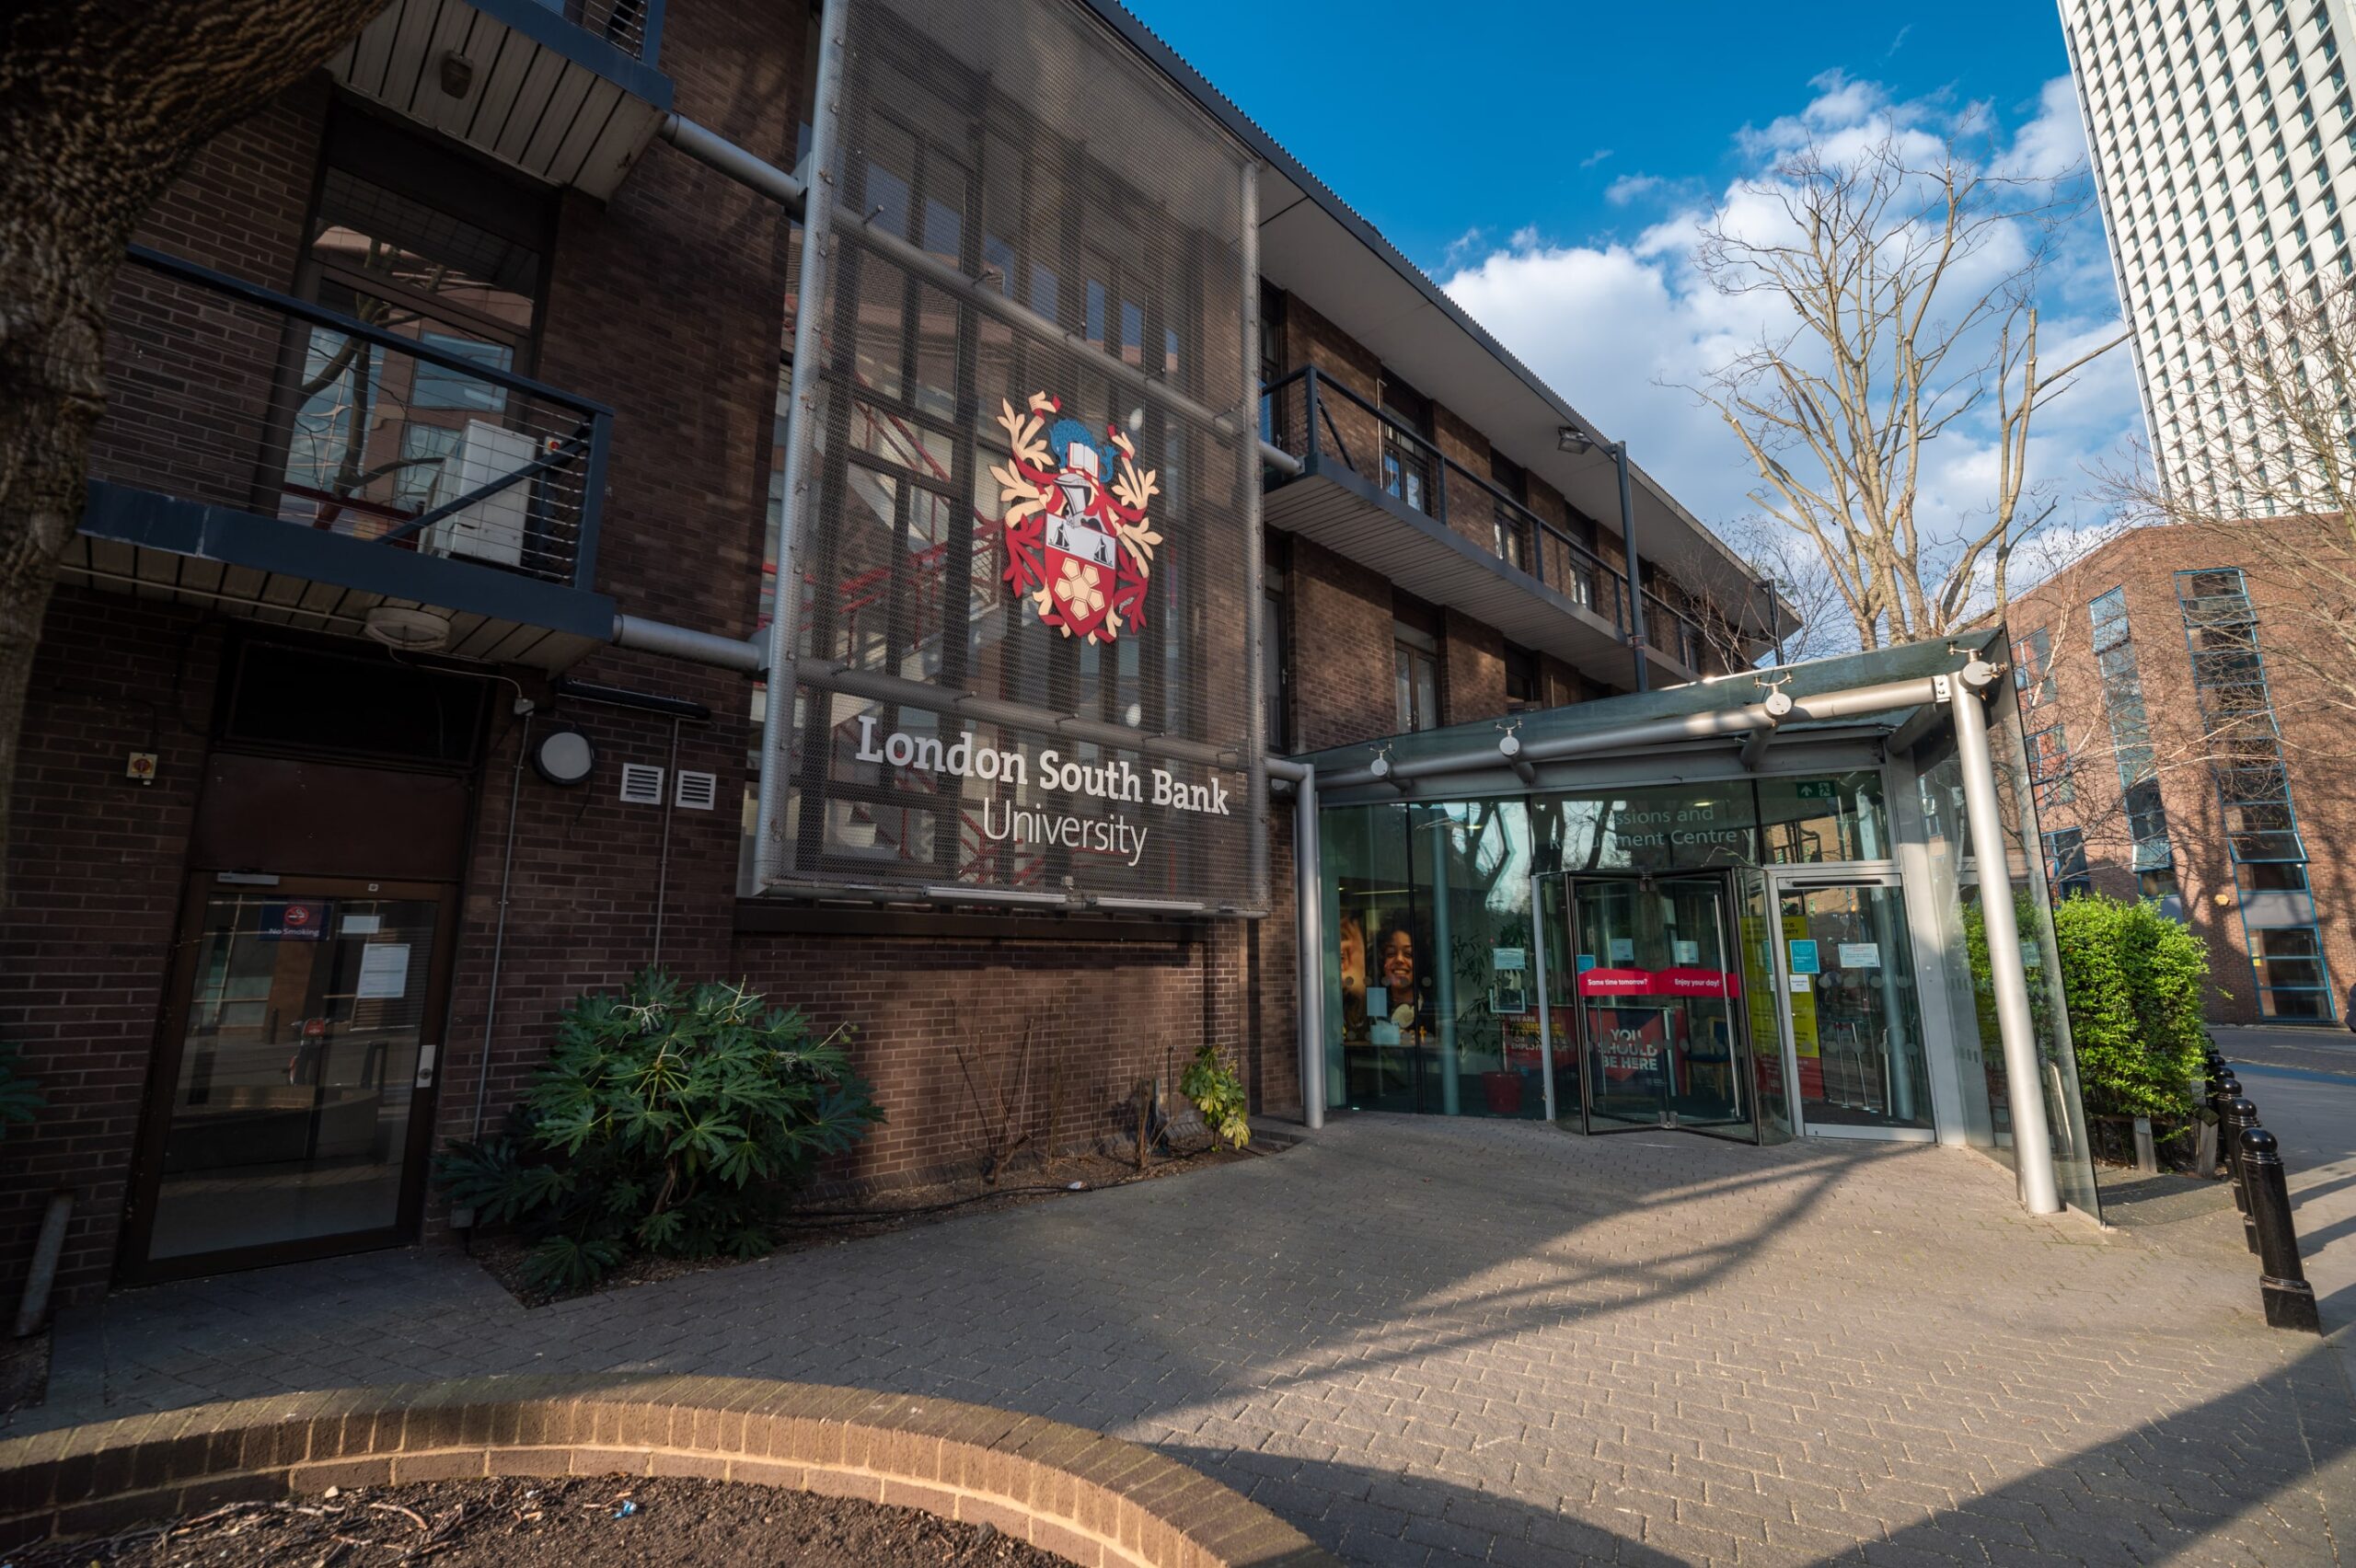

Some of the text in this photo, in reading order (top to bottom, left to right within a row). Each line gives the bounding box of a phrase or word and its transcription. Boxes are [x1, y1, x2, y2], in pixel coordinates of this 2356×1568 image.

[856, 715, 1230, 815] London South Bank
[1677, 807, 1715, 823] and
[984, 797, 1148, 867] University
[1670, 829, 1738, 847] Centre
[283, 928, 320, 938] Smoking
[1674, 978, 1691, 986] Enjoy
[1706, 979, 1720, 987] day!
[1611, 1029, 1642, 1042] YOU
[1598, 1042, 1658, 1056] SHOULD
[1603, 1055, 1658, 1071] BE HERE
